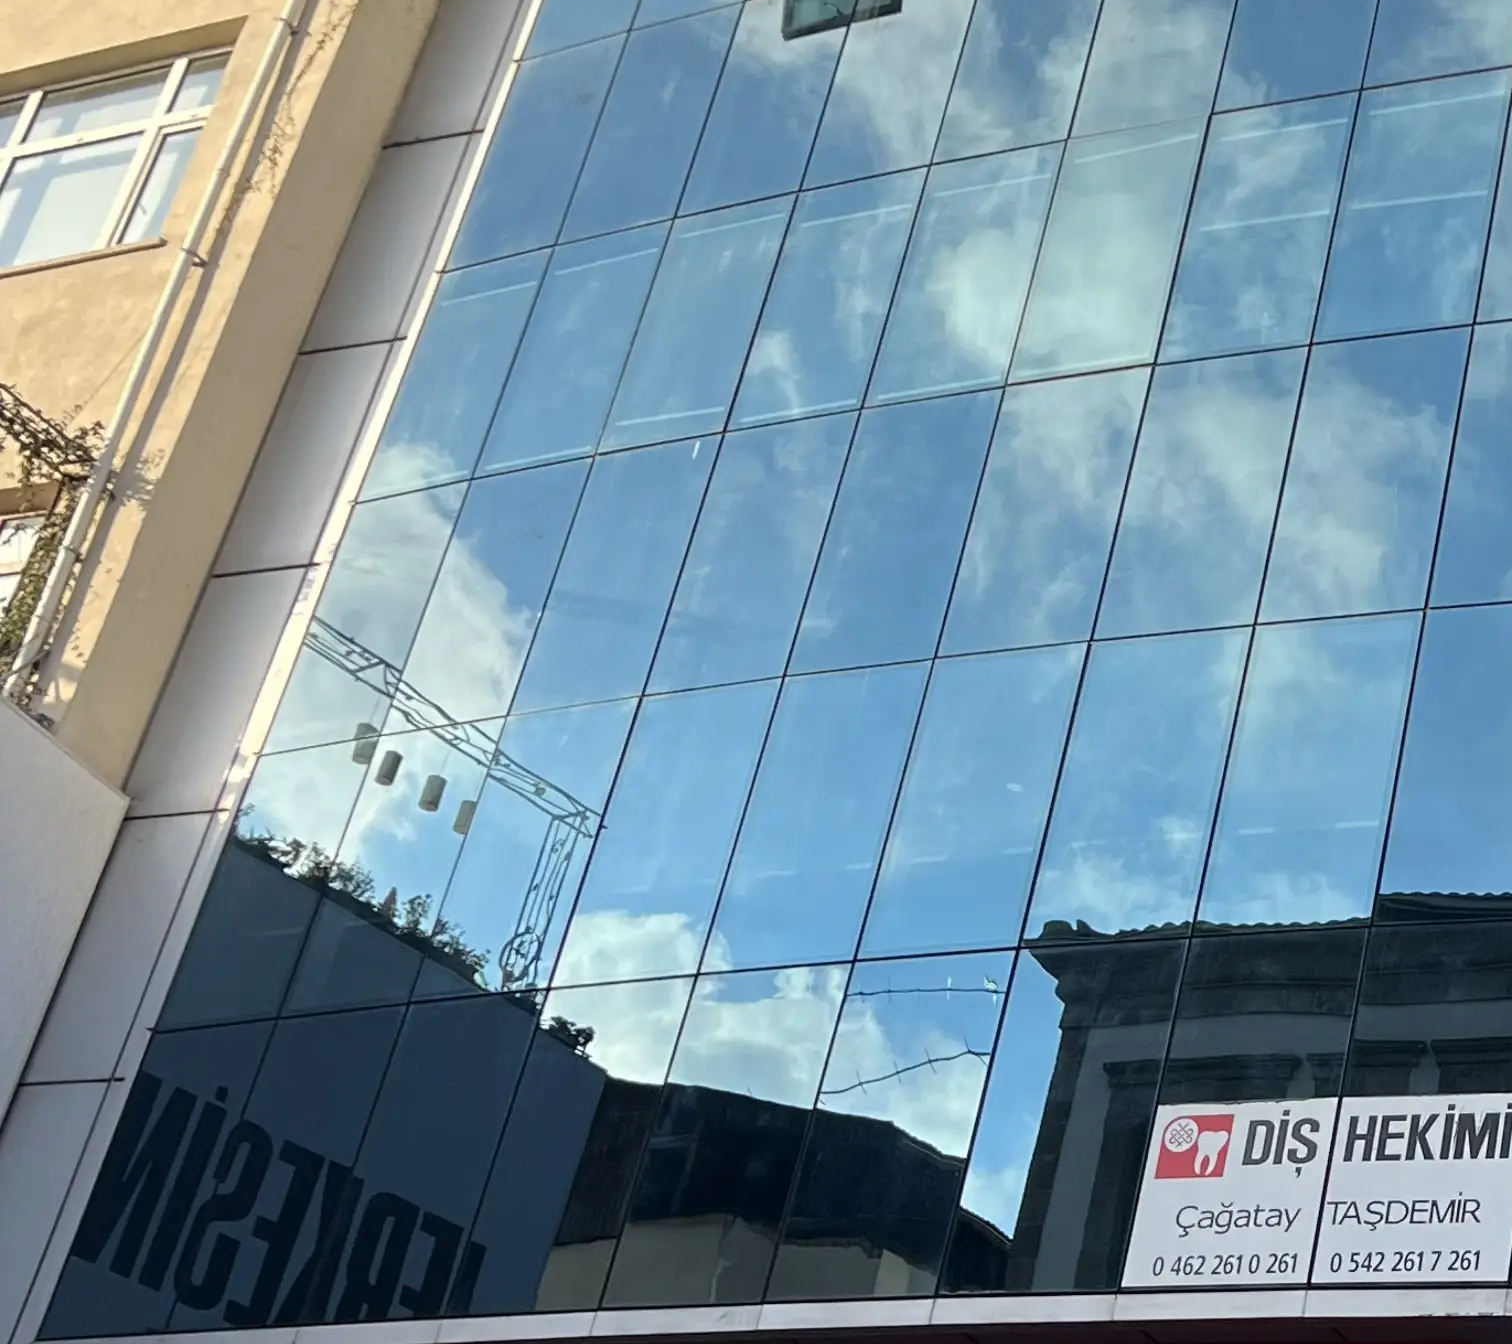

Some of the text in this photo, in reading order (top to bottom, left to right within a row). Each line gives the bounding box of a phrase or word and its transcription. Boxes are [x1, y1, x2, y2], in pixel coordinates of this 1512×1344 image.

[1242, 1109, 1320, 1178] DİŞ
[1175, 1192, 1481, 1238] Çağatay TAŞDEMİR
[1152, 1252, 1298, 1277] 0 462 261 0 261
[1329, 1252, 1342, 1273] 0
[1348, 1251, 1385, 1273] 542
[1391, 1251, 1423, 1273] 261
[1449, 1249, 1481, 1272] 261
